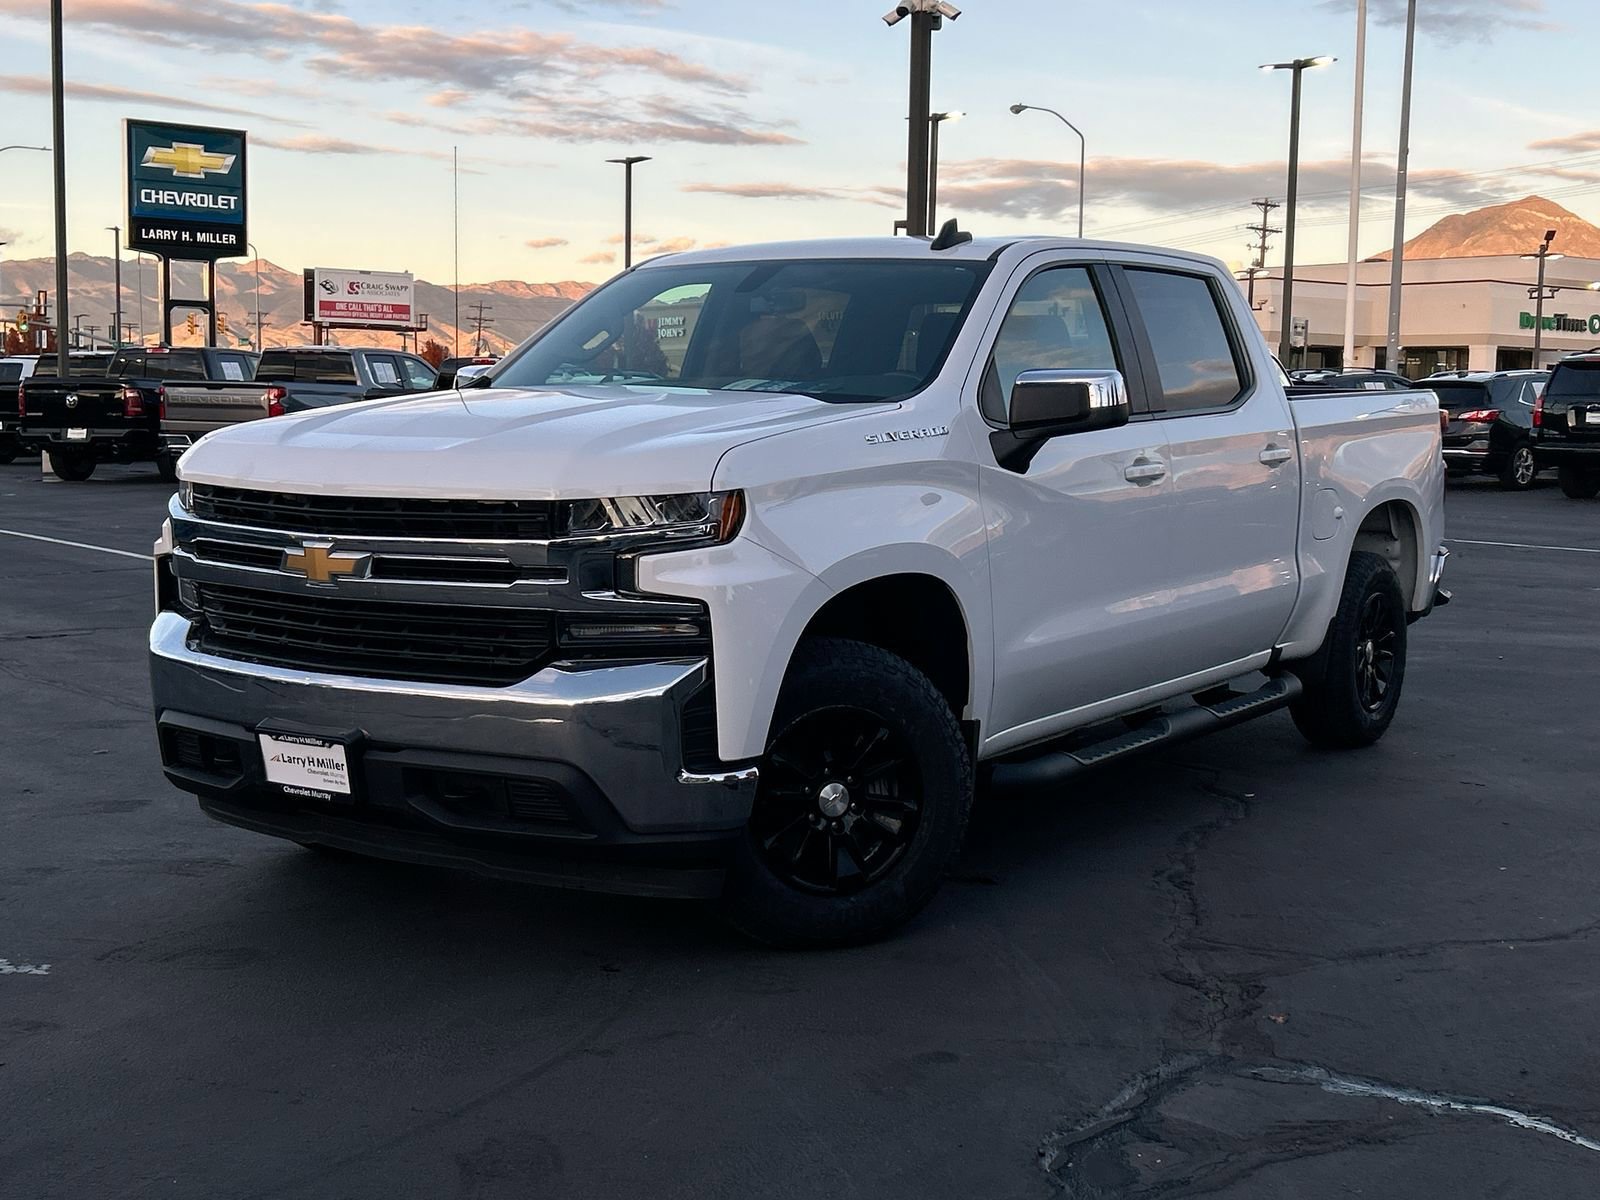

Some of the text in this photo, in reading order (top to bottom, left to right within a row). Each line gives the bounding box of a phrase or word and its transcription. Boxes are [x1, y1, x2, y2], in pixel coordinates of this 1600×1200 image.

[140, 189, 238, 210] CHEVROLET
[142, 228, 236, 245] LARRY H. MILLER
[360, 281, 409, 292] CRAIG SWAPP
[335, 303, 393, 313] ONE CALL THAT'S ALL
[658, 316, 684, 328] JIMMY
[1519, 311, 1587, 332] DrveTime
[657, 328, 684, 339] JOHN'S
[169, 394, 260, 405] CHEVROLET
[864, 425, 949, 445] SILVERADO
[284, 735, 300, 744] Larry
[305, 737, 323, 746] Miller
[281, 753, 345, 771] Larry H Miller
[307, 768, 330, 777] Chevrolet
[283, 785, 332, 801] Chevrolet Murray
